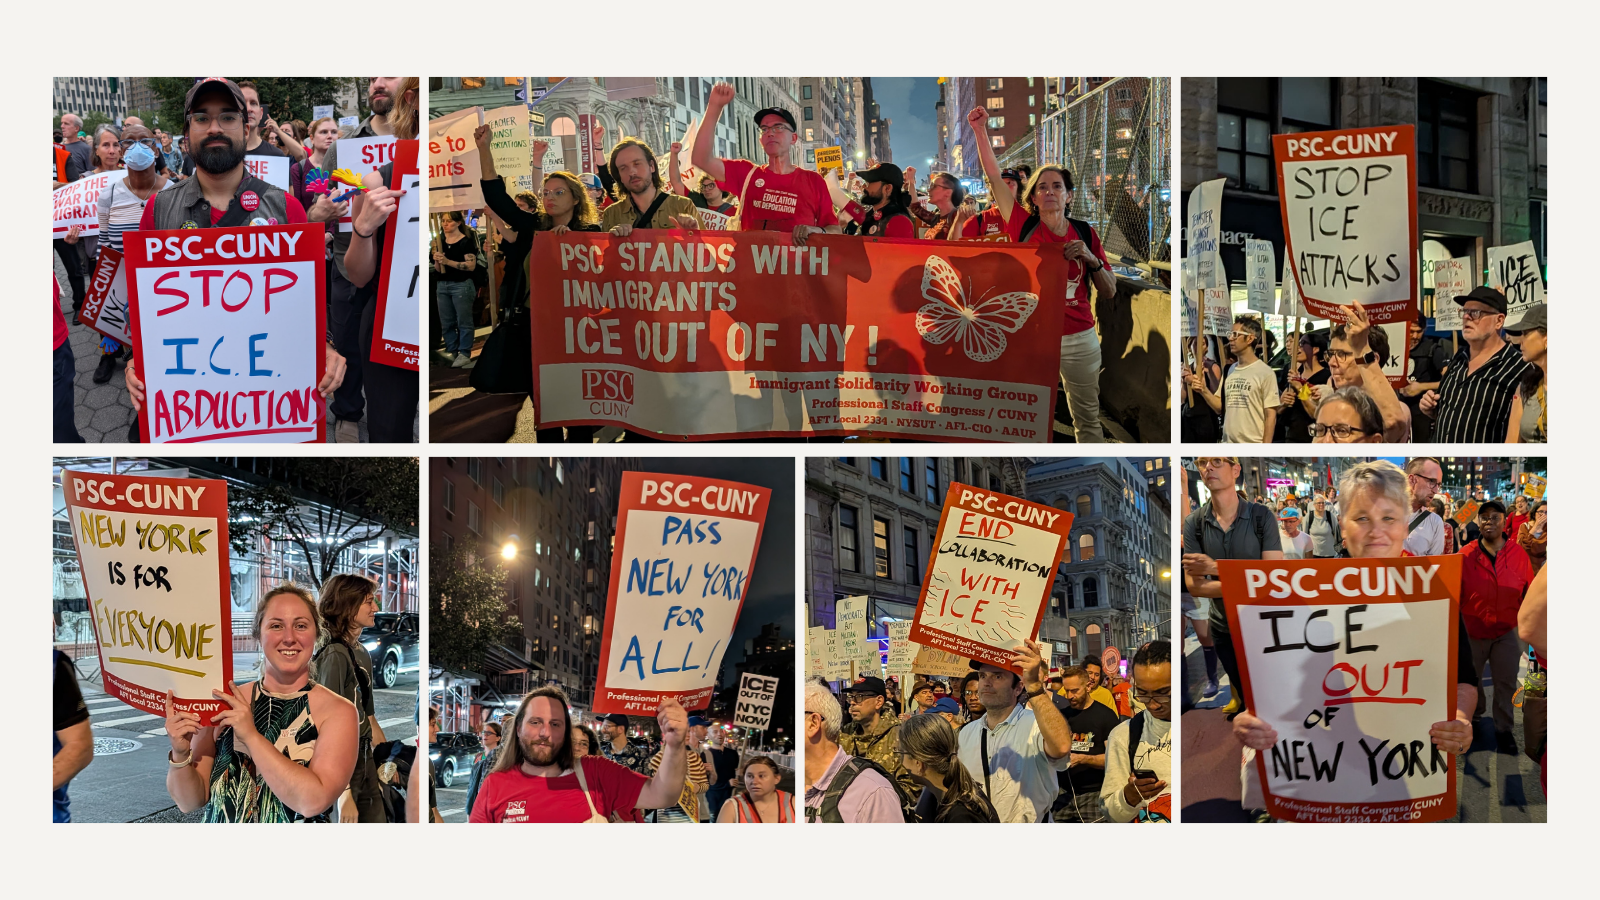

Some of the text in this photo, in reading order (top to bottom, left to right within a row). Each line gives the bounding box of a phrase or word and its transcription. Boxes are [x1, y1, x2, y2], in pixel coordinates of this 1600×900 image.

[362, 142, 397, 165] STO
[446, 136, 466, 152] to
[1286, 131, 1398, 158] PSC-CUNY
[817, 154, 841, 164] PLENOS
[53, 176, 109, 201] STOP THE
[1294, 164, 1392, 199] STOP
[54, 193, 81, 209] WAR
[761, 203, 795, 214] DEPORTATION
[763, 193, 797, 206] EDUCATION
[700, 211, 717, 222] TOP
[1310, 205, 1359, 241] ICE
[145, 230, 304, 262] PSC-CUNY
[560, 242, 829, 277] PSC STANDS WITH
[1300, 253, 1400, 290] ATTACKS
[1500, 254, 1535, 288] ICE
[83, 254, 116, 321] PSC-CUNY
[153, 268, 298, 317] STOP
[563, 280, 737, 312] IMMIGRANTS
[1505, 277, 1539, 306] OUT
[1307, 300, 1335, 312] Professional
[385, 343, 419, 357] Profess
[565, 317, 623, 355] ICE
[635, 320, 705, 364] OUT
[726, 320, 779, 361] OF
[802, 324, 855, 363] NY
[162, 332, 281, 378] I.C.E.
[583, 369, 634, 405] PSC
[749, 377, 1038, 405] Immigrant Solidarity Working Group
[154, 387, 326, 438] ABDUCTIONS
[589, 401, 631, 419] CUNY
[811, 398, 888, 410] Professional
[891, 400, 924, 412] Staff
[926, 402, 985, 419] Congress
[997, 408, 1038, 423] CUNY
[807, 414, 1037, 440] AFT Local 2334 NYSUT AFL-CIO AAUP
[72, 477, 206, 512] PSC-CUNY
[640, 480, 760, 515] PSC-CUNY
[959, 489, 1060, 529] PSC-CUNY
[1456, 502, 1478, 522] SOS
[79, 510, 214, 557] NEW YORK
[662, 515, 722, 546] PASS
[958, 511, 1015, 540] END
[939, 539, 1051, 579] COLLABORATION
[107, 560, 173, 593] IS FOR
[627, 556, 747, 601] NEW YORK
[960, 567, 1020, 600] WITH
[1244, 564, 1440, 598] PSC-CUNY
[663, 605, 704, 633] FOR
[837, 610, 863, 623] DEMOCRATS
[939, 588, 990, 625] ICE
[94, 597, 217, 661] EVERYONE
[919, 627, 956, 645] Professional
[956, 638, 971, 649] Staff
[1259, 604, 1379, 655] ICE
[620, 634, 721, 680] ALL!
[927, 650, 961, 665] DYLAN
[930, 639, 1007, 665] AFT Local 2334 AFL-CIO
[107, 676, 139, 697] Professional
[140, 689, 155, 702] Staff
[742, 676, 776, 694] ICE
[1322, 659, 1424, 697] OUT
[119, 690, 164, 713] AFT Local 2334
[607, 691, 660, 704] Professional
[624, 702, 657, 712] AFT Loc
[737, 702, 770, 716] NYC
[740, 690, 773, 701] OUT OF
[736, 713, 769, 727] NOW
[1303, 706, 1340, 730] OF
[1271, 738, 1449, 786] NEW YORK
[507, 801, 526, 810] PSC
[1273, 797, 1444, 816] Professional Staff Congress/CUNY
[1296, 810, 1421, 823] AFT Local 2334 AFL-CIO
